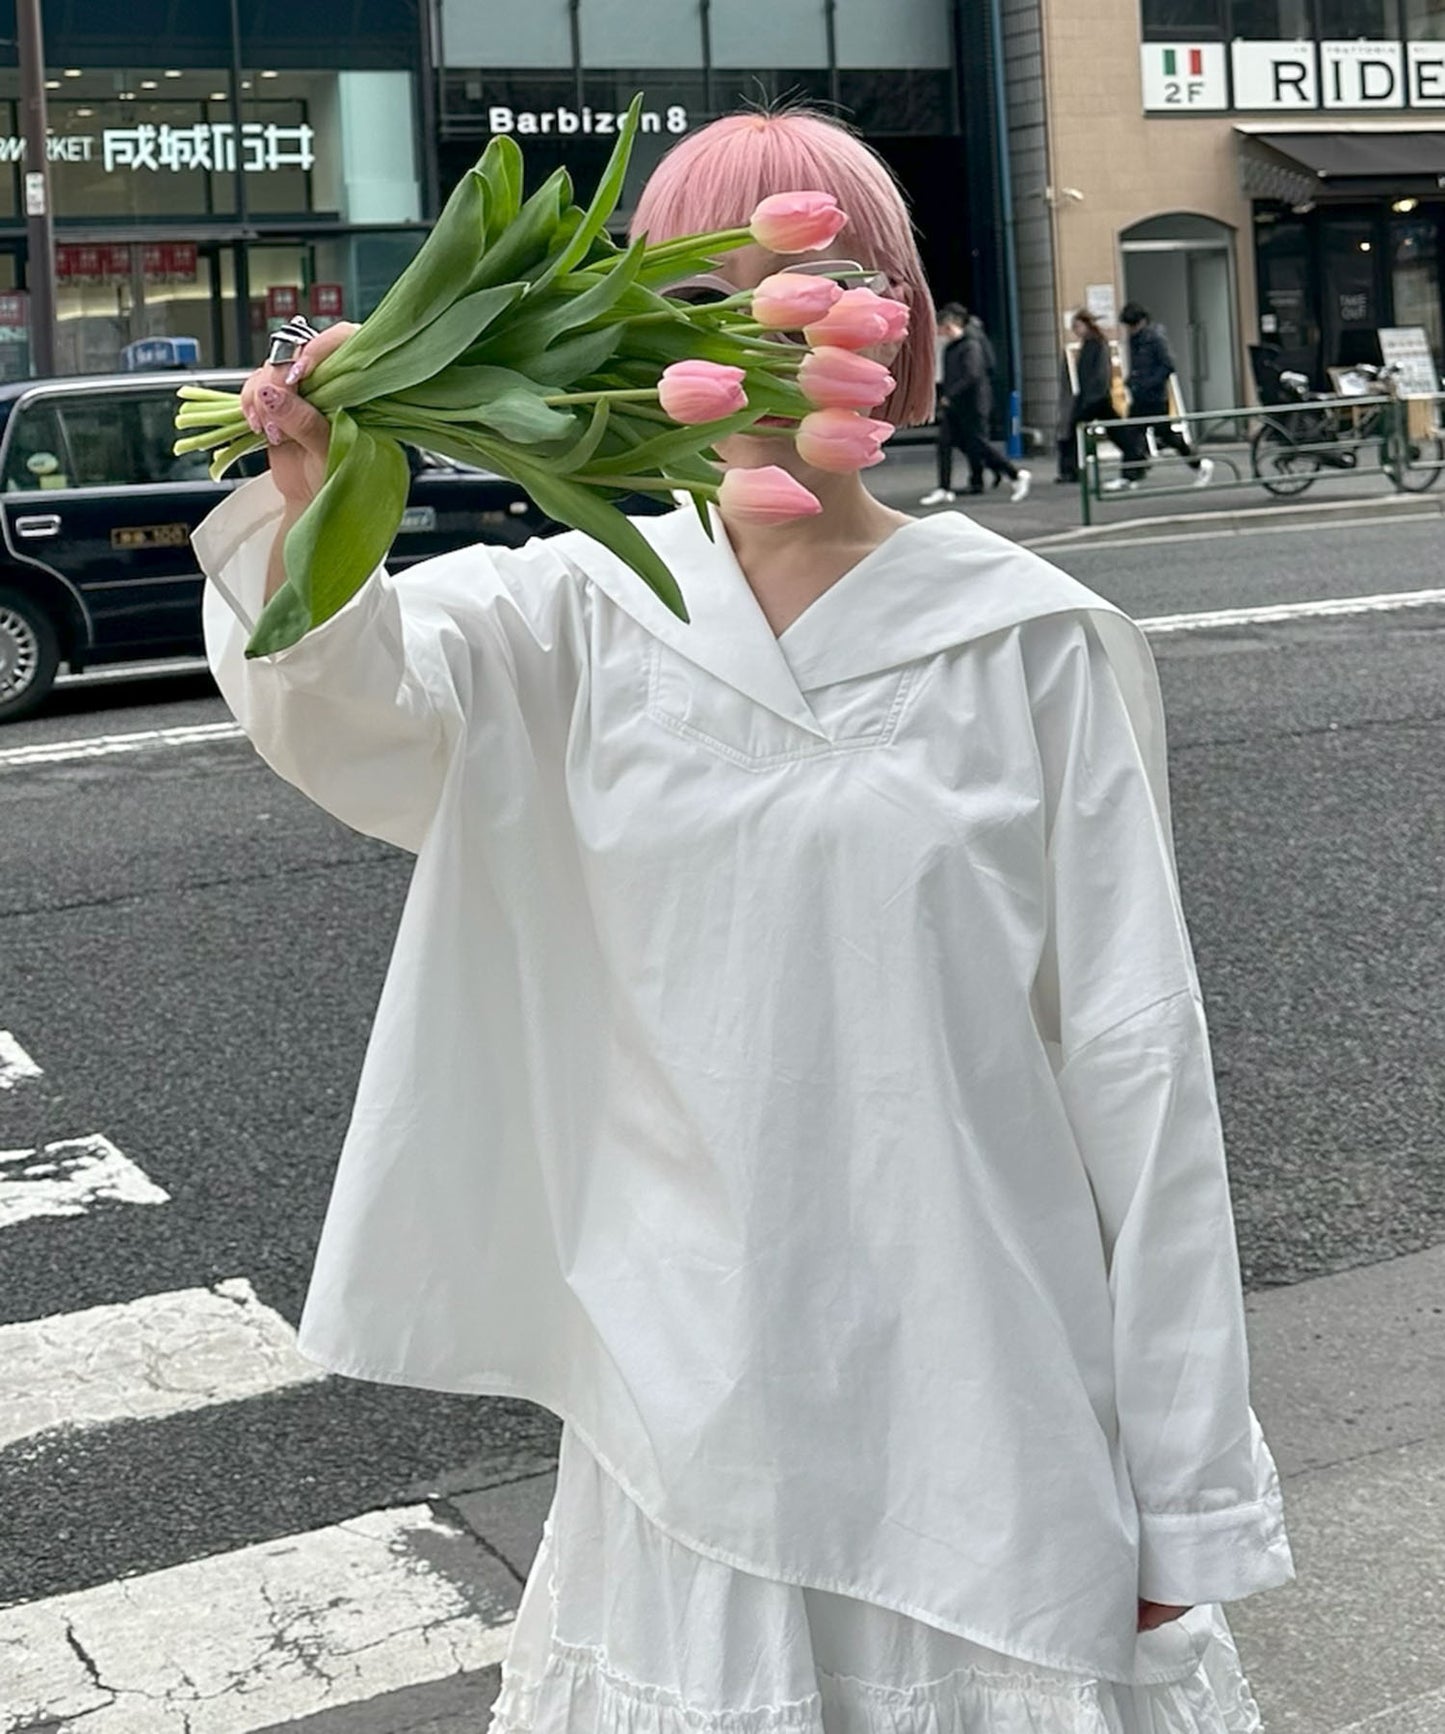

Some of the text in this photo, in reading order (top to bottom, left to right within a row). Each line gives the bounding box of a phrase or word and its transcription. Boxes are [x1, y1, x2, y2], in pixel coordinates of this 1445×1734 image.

[1164, 82, 1205, 104] 2F
[1270, 60, 1445, 102] RIDE
[103, 124, 315, 171] 成城石井
